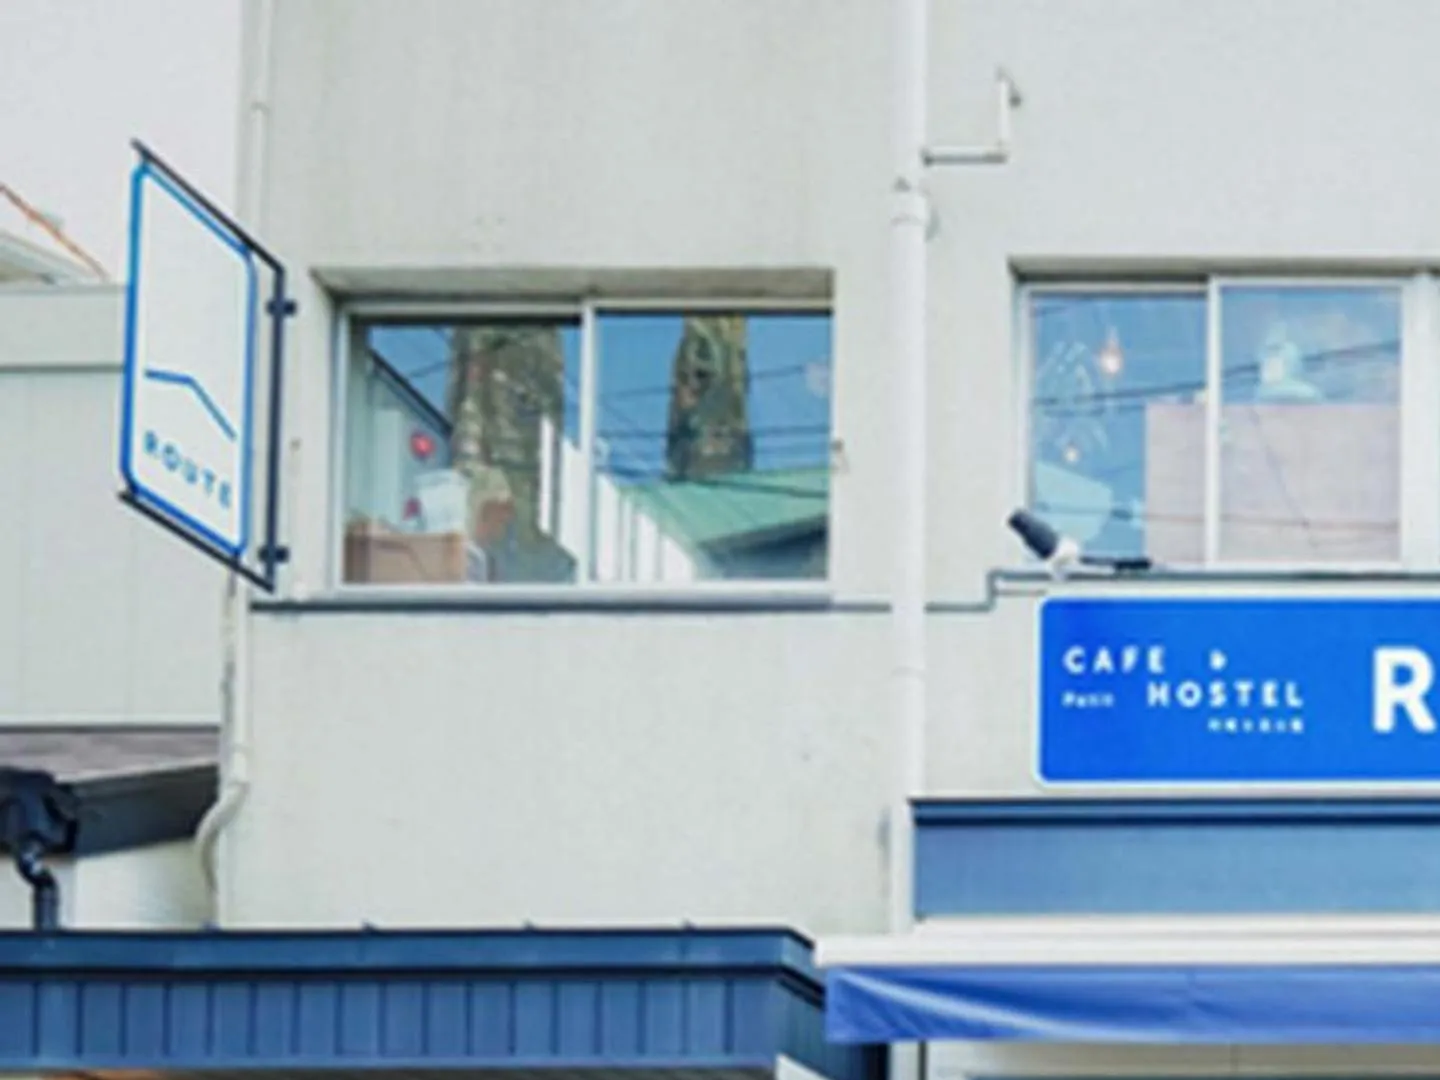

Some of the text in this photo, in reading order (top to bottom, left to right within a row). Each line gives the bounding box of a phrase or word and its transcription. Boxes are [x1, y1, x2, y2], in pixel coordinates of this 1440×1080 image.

[143, 429, 232, 510] ROUTE
[1063, 645, 1165, 674] CAFE
[1148, 680, 1304, 708] HOSTEL
